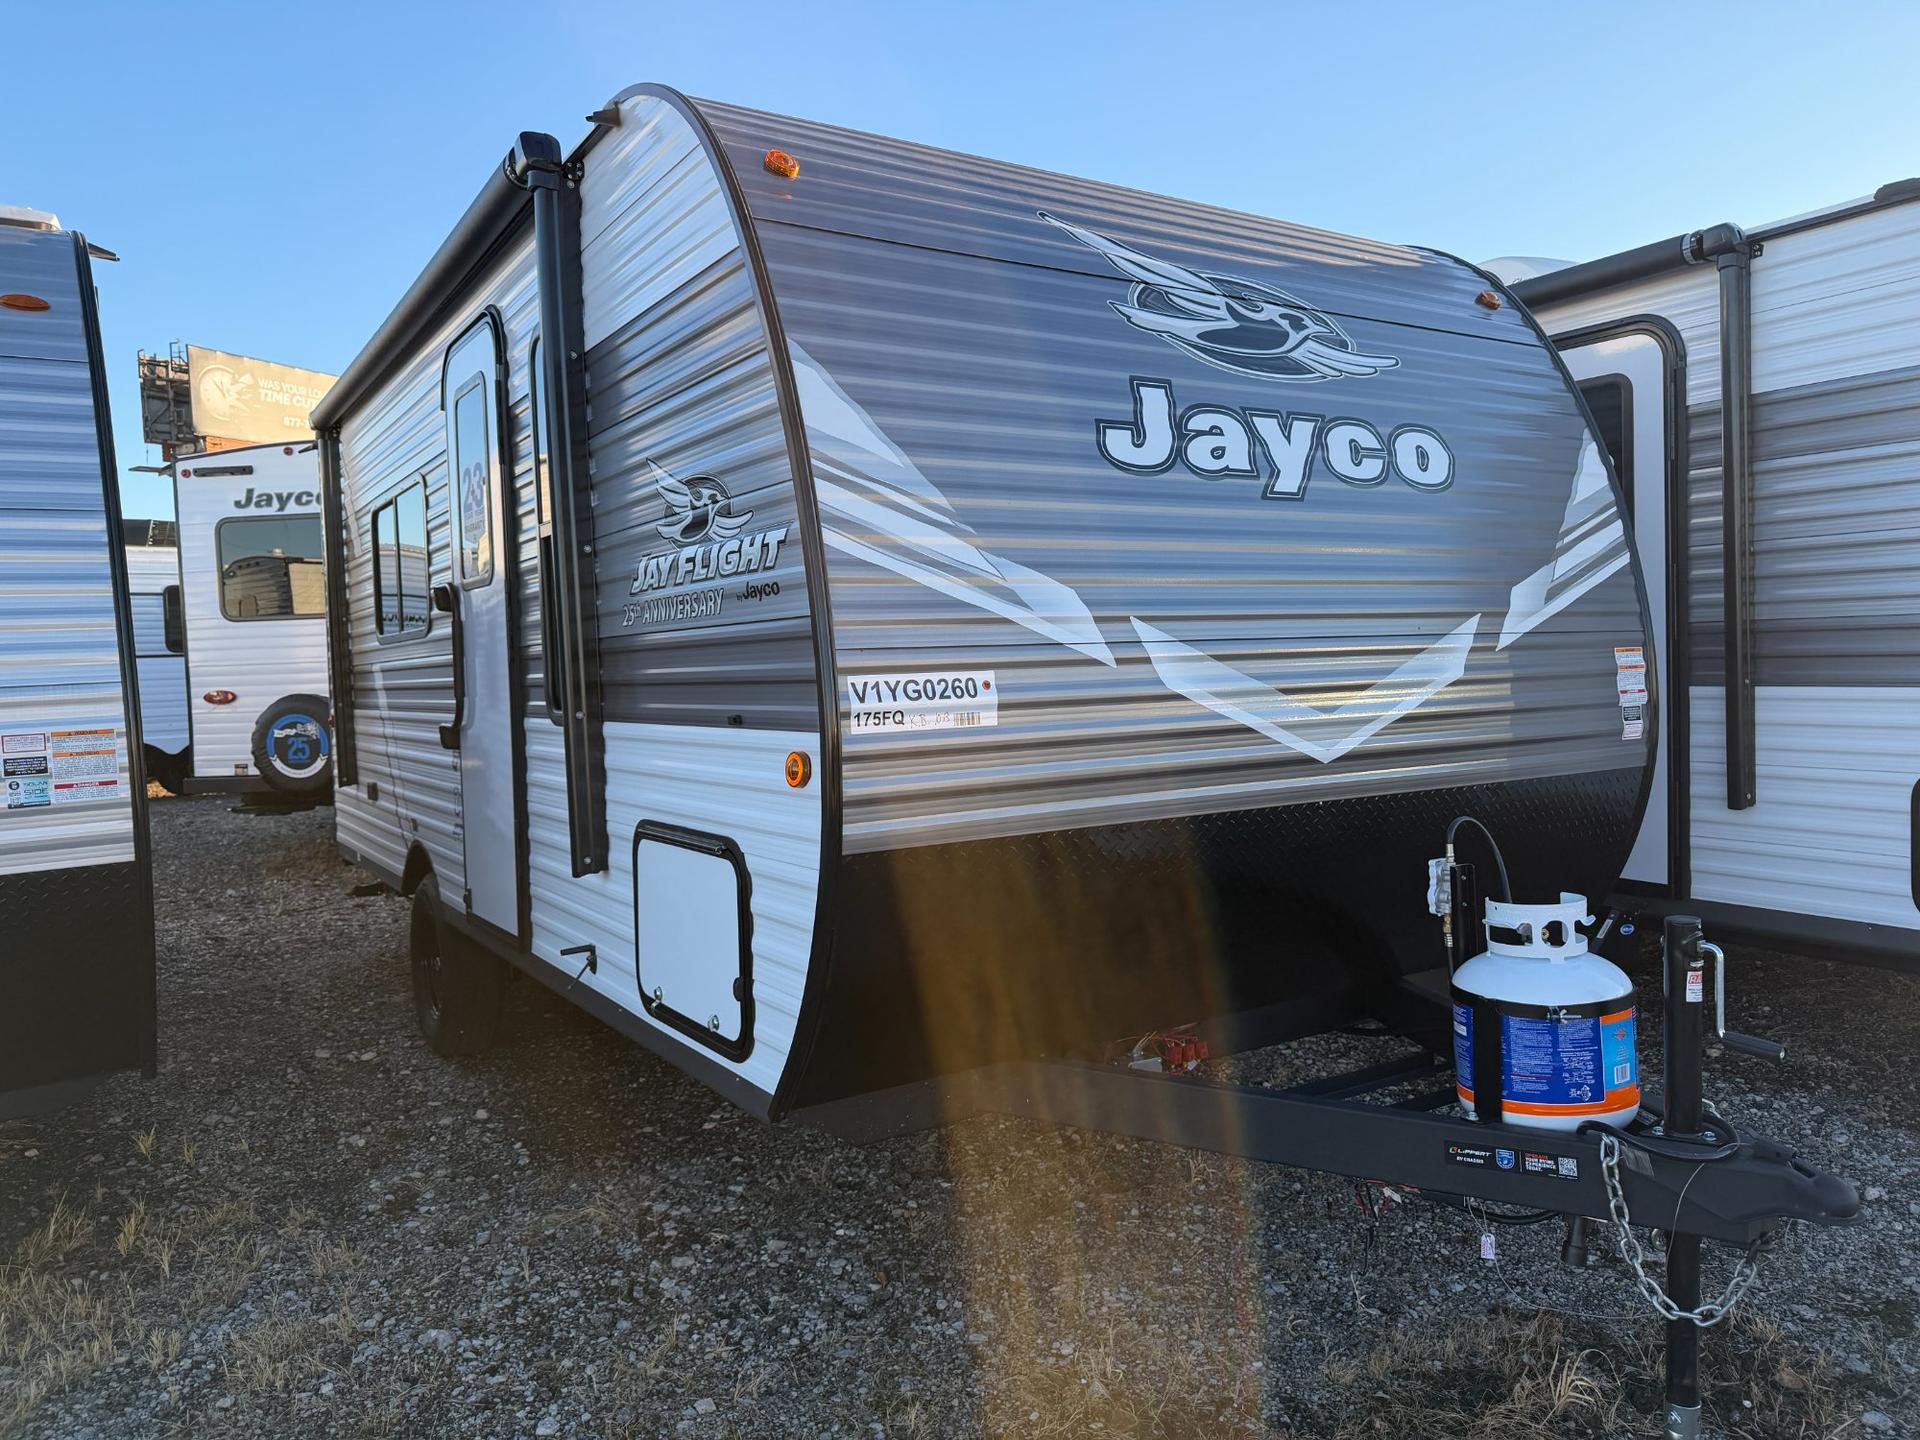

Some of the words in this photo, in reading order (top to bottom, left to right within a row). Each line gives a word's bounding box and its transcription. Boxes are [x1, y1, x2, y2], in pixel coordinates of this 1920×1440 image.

[257, 378, 280, 391] WAS
[282, 382, 306, 395] YOUR
[307, 387, 320, 398] LO
[259, 390, 290, 404] TIME
[1095, 375, 1455, 501] Jayco
[233, 488, 322, 512] Jayc
[630, 552, 677, 595] JAY
[675, 527, 788, 585] FLIGHT
[743, 581, 780, 601] Jayco
[622, 601, 642, 627] 25th
[643, 588, 724, 624] ANNIVERSARY
[850, 677, 978, 704] V1YG0260
[853, 710, 905, 727] 175FQ
[288, 737, 311, 763] 25
[1457, 1148, 1493, 1156] LIPPERT
